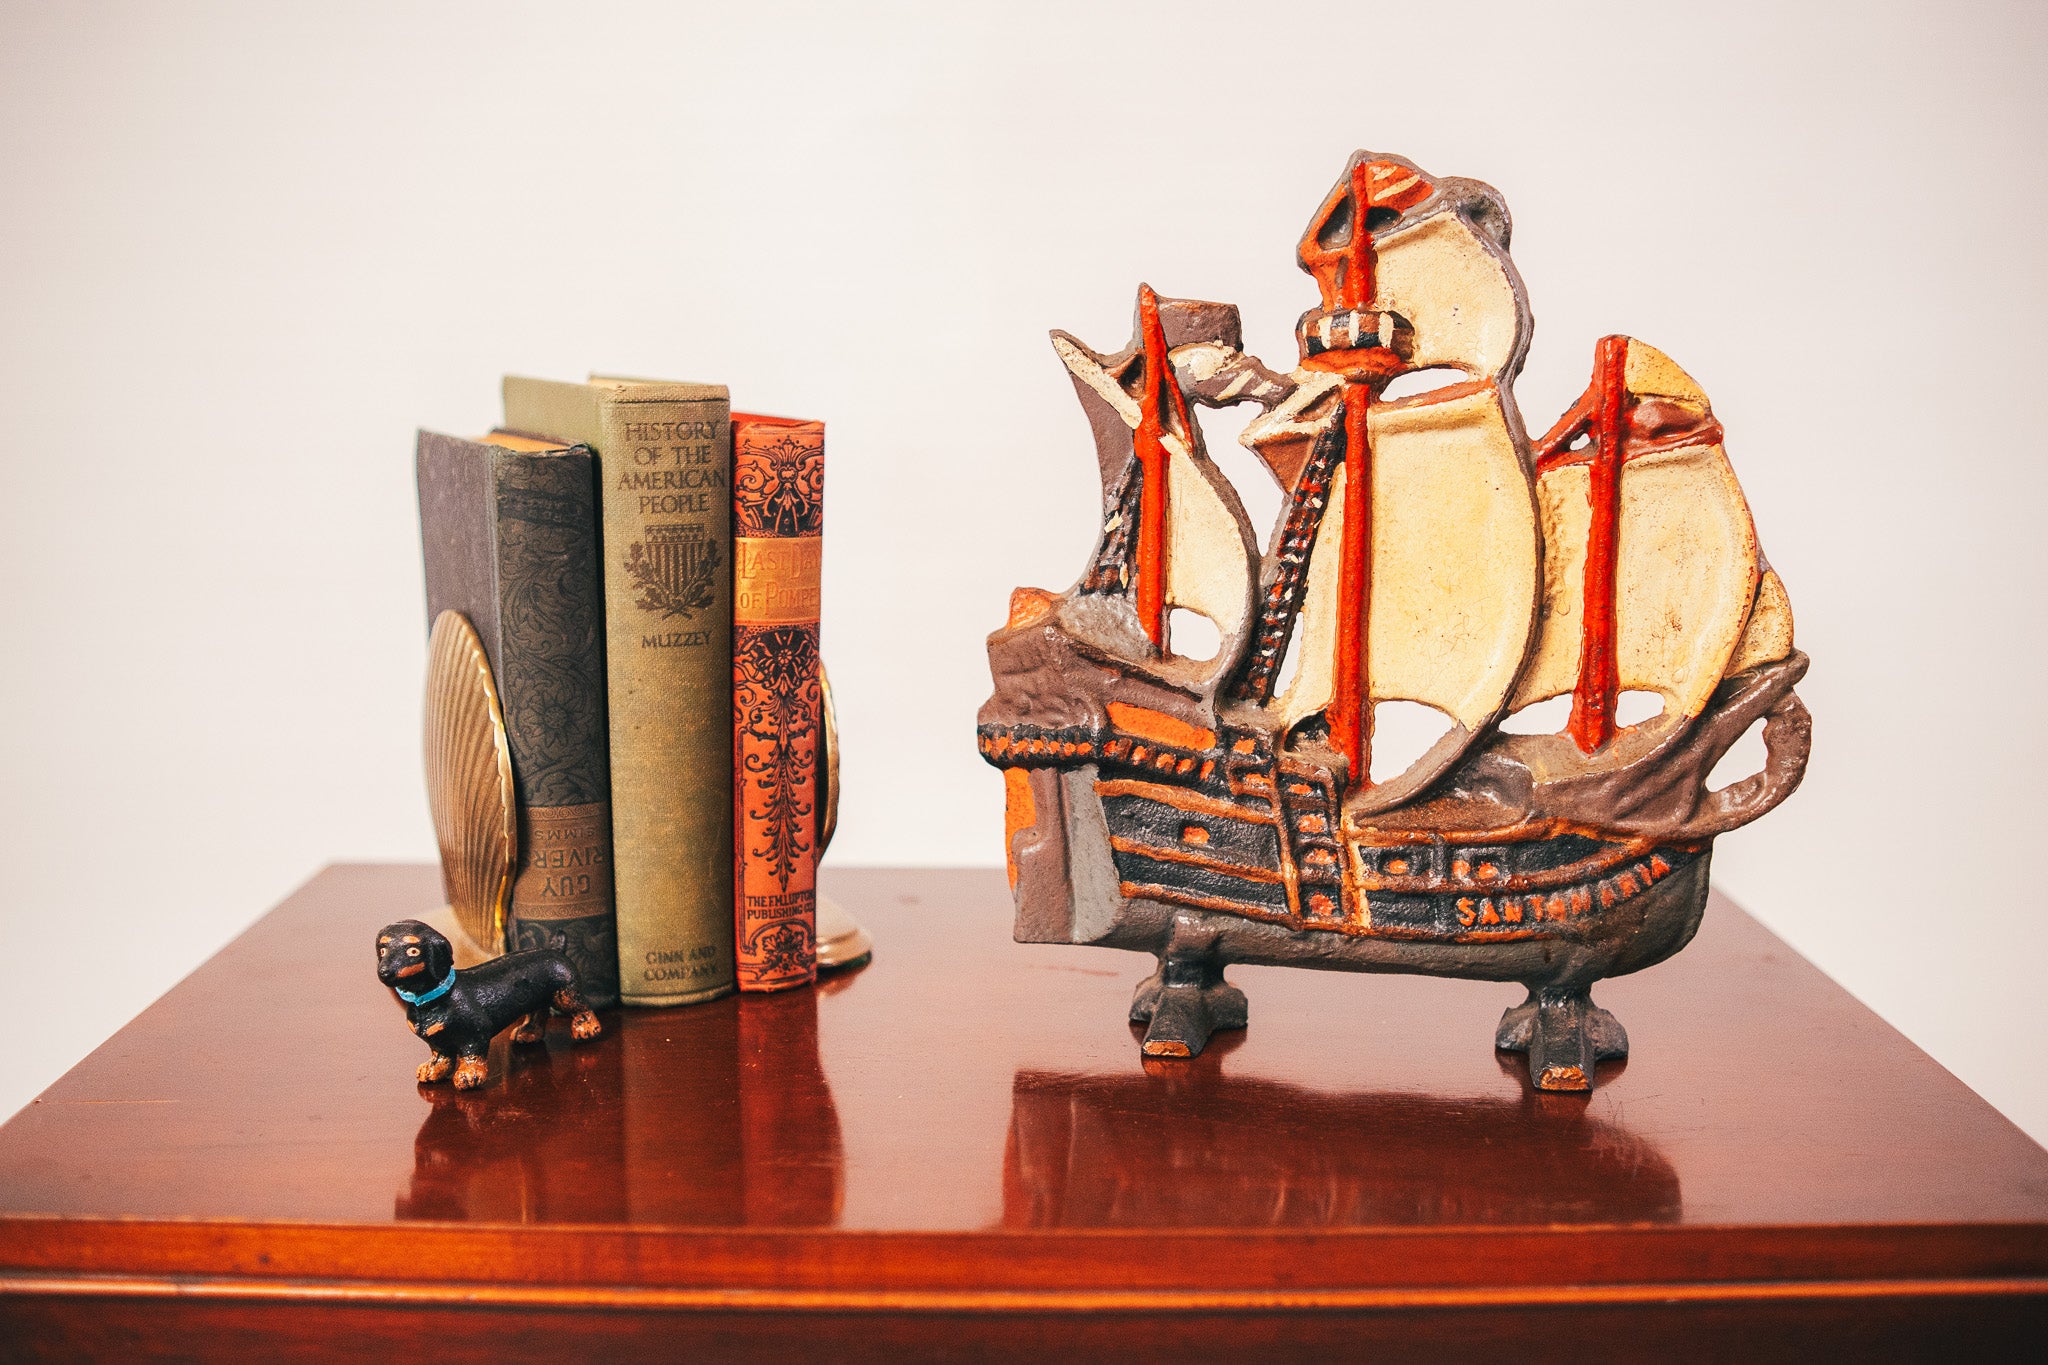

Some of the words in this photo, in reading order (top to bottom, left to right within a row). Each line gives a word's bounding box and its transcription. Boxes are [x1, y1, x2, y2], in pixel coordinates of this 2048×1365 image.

[625, 421, 720, 441] HISTORY
[634, 446, 662, 466] OF
[671, 445, 712, 465] THE
[618, 468, 726, 490] AMERICAN
[639, 493, 711, 514] PEOPLE
[740, 592, 762, 609] OF
[641, 631, 712, 649] MUZZEY
[534, 826, 595, 840] SIMMS
[526, 846, 603, 868] RIVER
[541, 874, 591, 896] GUY
[746, 895, 768, 907] THE
[747, 904, 803, 920] PUBLISHING
[645, 950, 684, 964] GINN
[688, 945, 717, 960] AND
[643, 963, 718, 980] COMPANY
